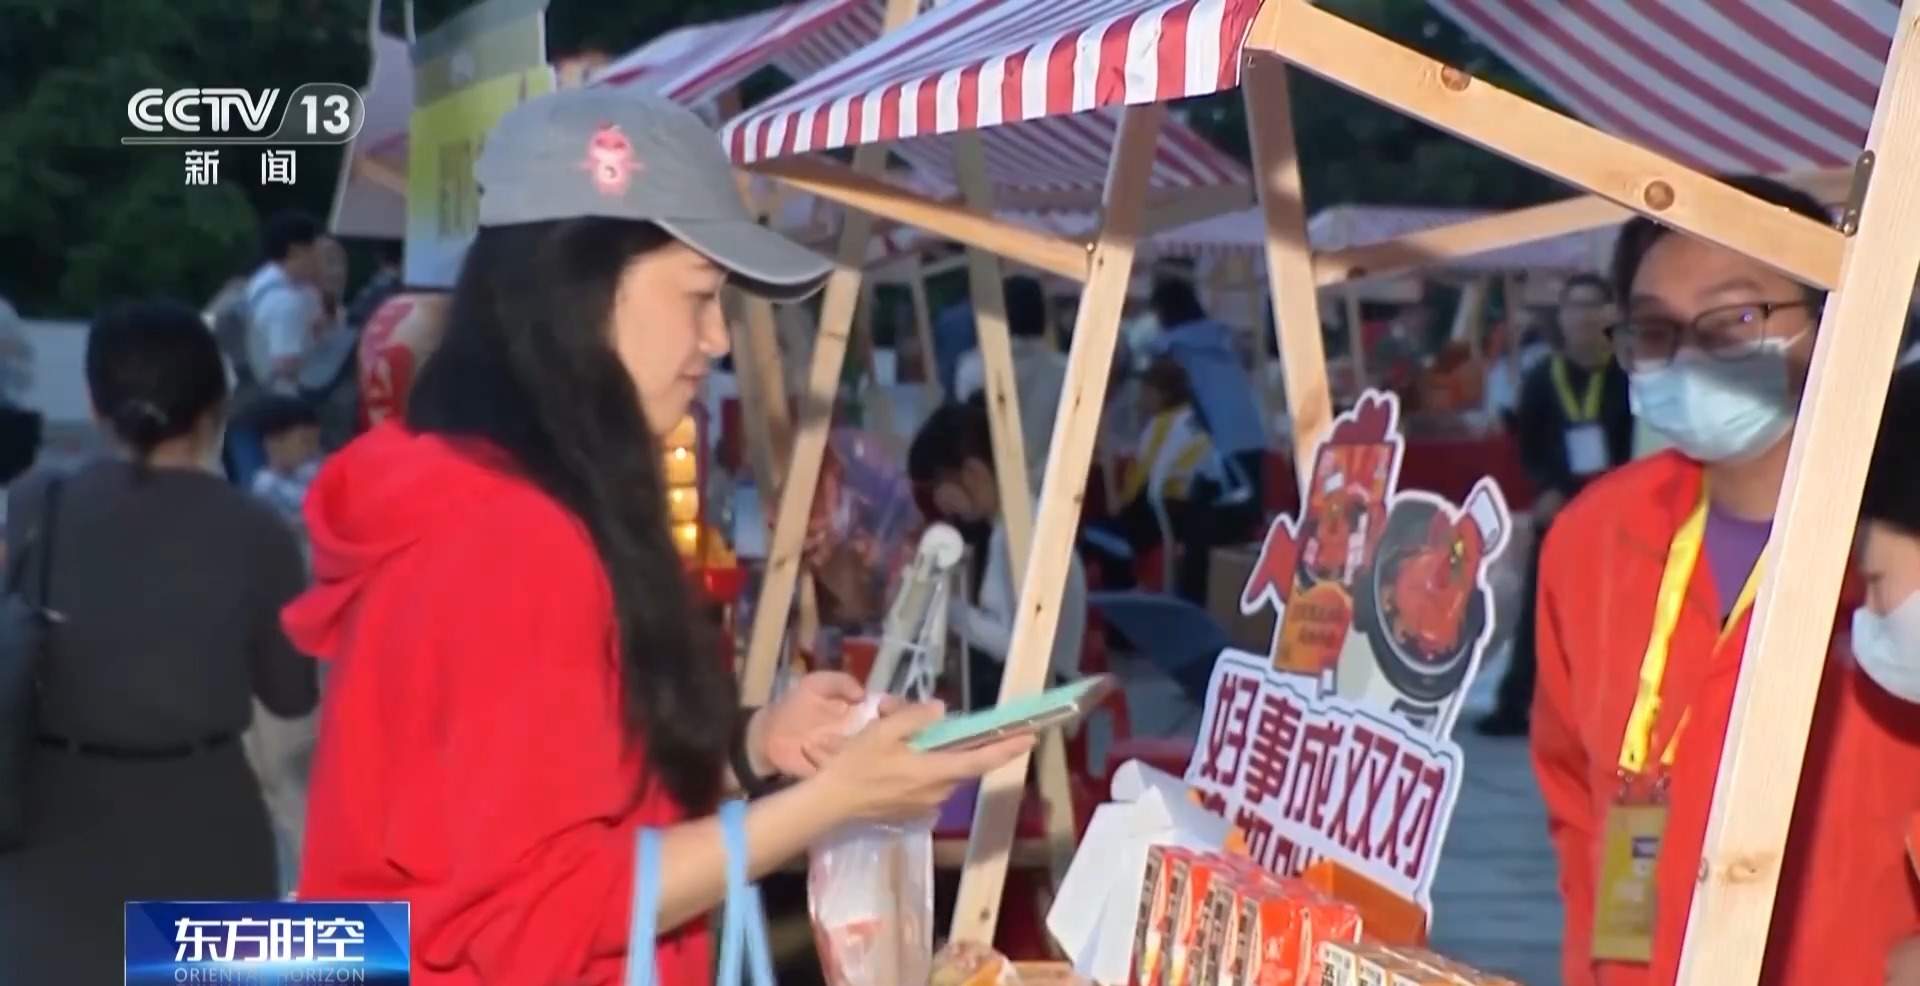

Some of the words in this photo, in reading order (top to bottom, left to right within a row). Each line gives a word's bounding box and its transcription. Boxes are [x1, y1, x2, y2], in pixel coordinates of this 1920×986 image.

[1200, 671, 1446, 880] 好事成双对
